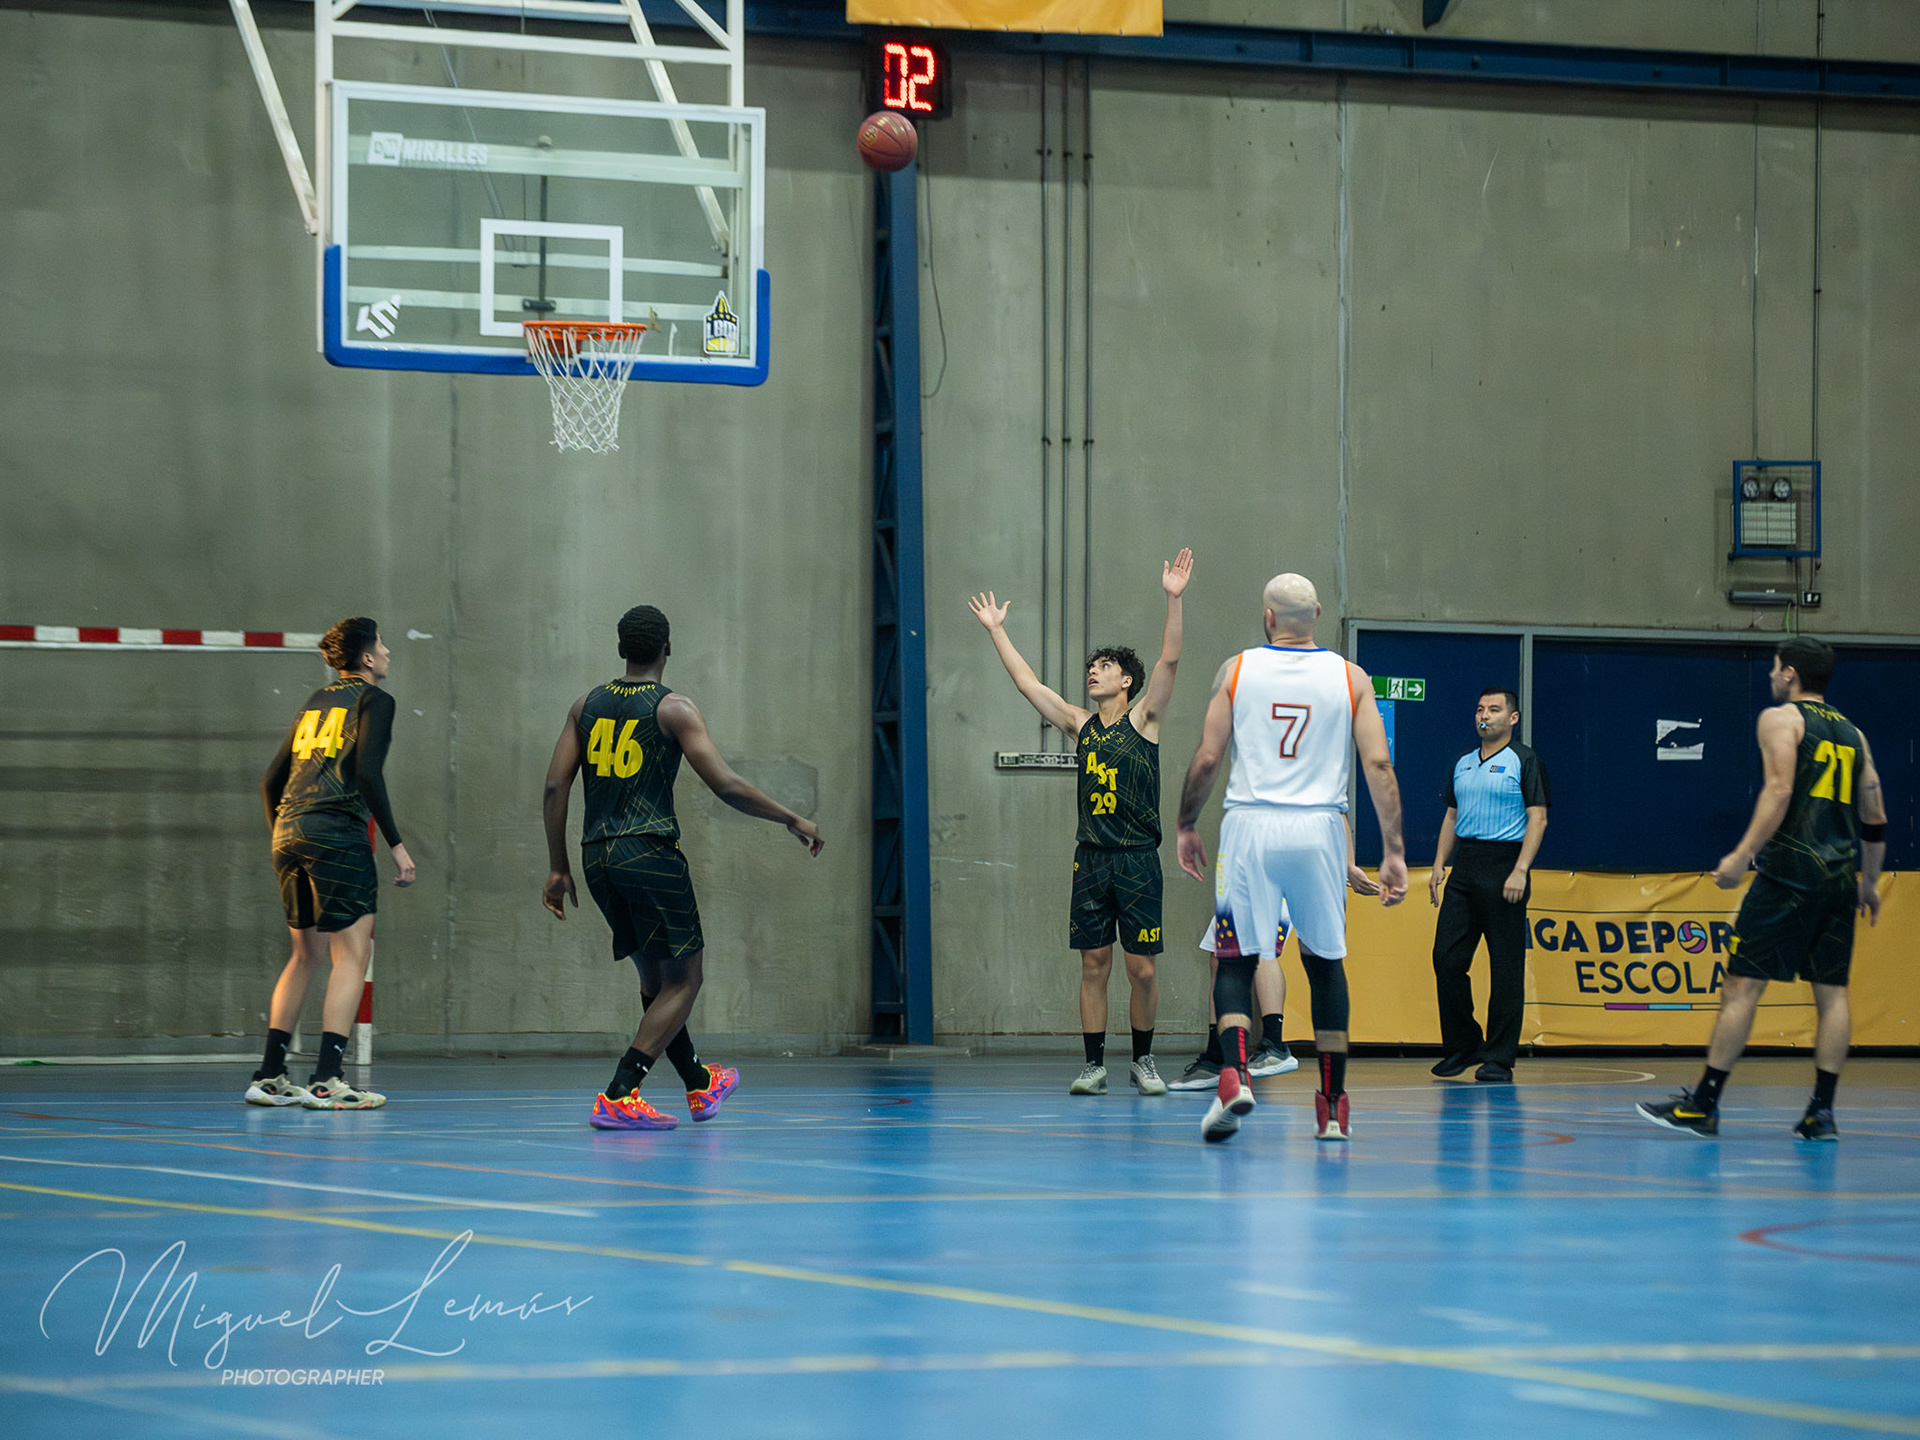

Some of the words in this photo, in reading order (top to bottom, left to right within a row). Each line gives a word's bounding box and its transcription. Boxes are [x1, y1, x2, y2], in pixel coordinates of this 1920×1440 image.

[884, 42, 935, 111] 02
[402, 139, 488, 165] MIRALLES
[292, 707, 348, 760] 44
[587, 717, 643, 779] 46
[1271, 702, 1312, 760] 7
[1086, 751, 1118, 791] AST
[1809, 740, 1856, 805] 21
[1090, 791, 1118, 815] 29
[1137, 926, 1161, 943] AST
